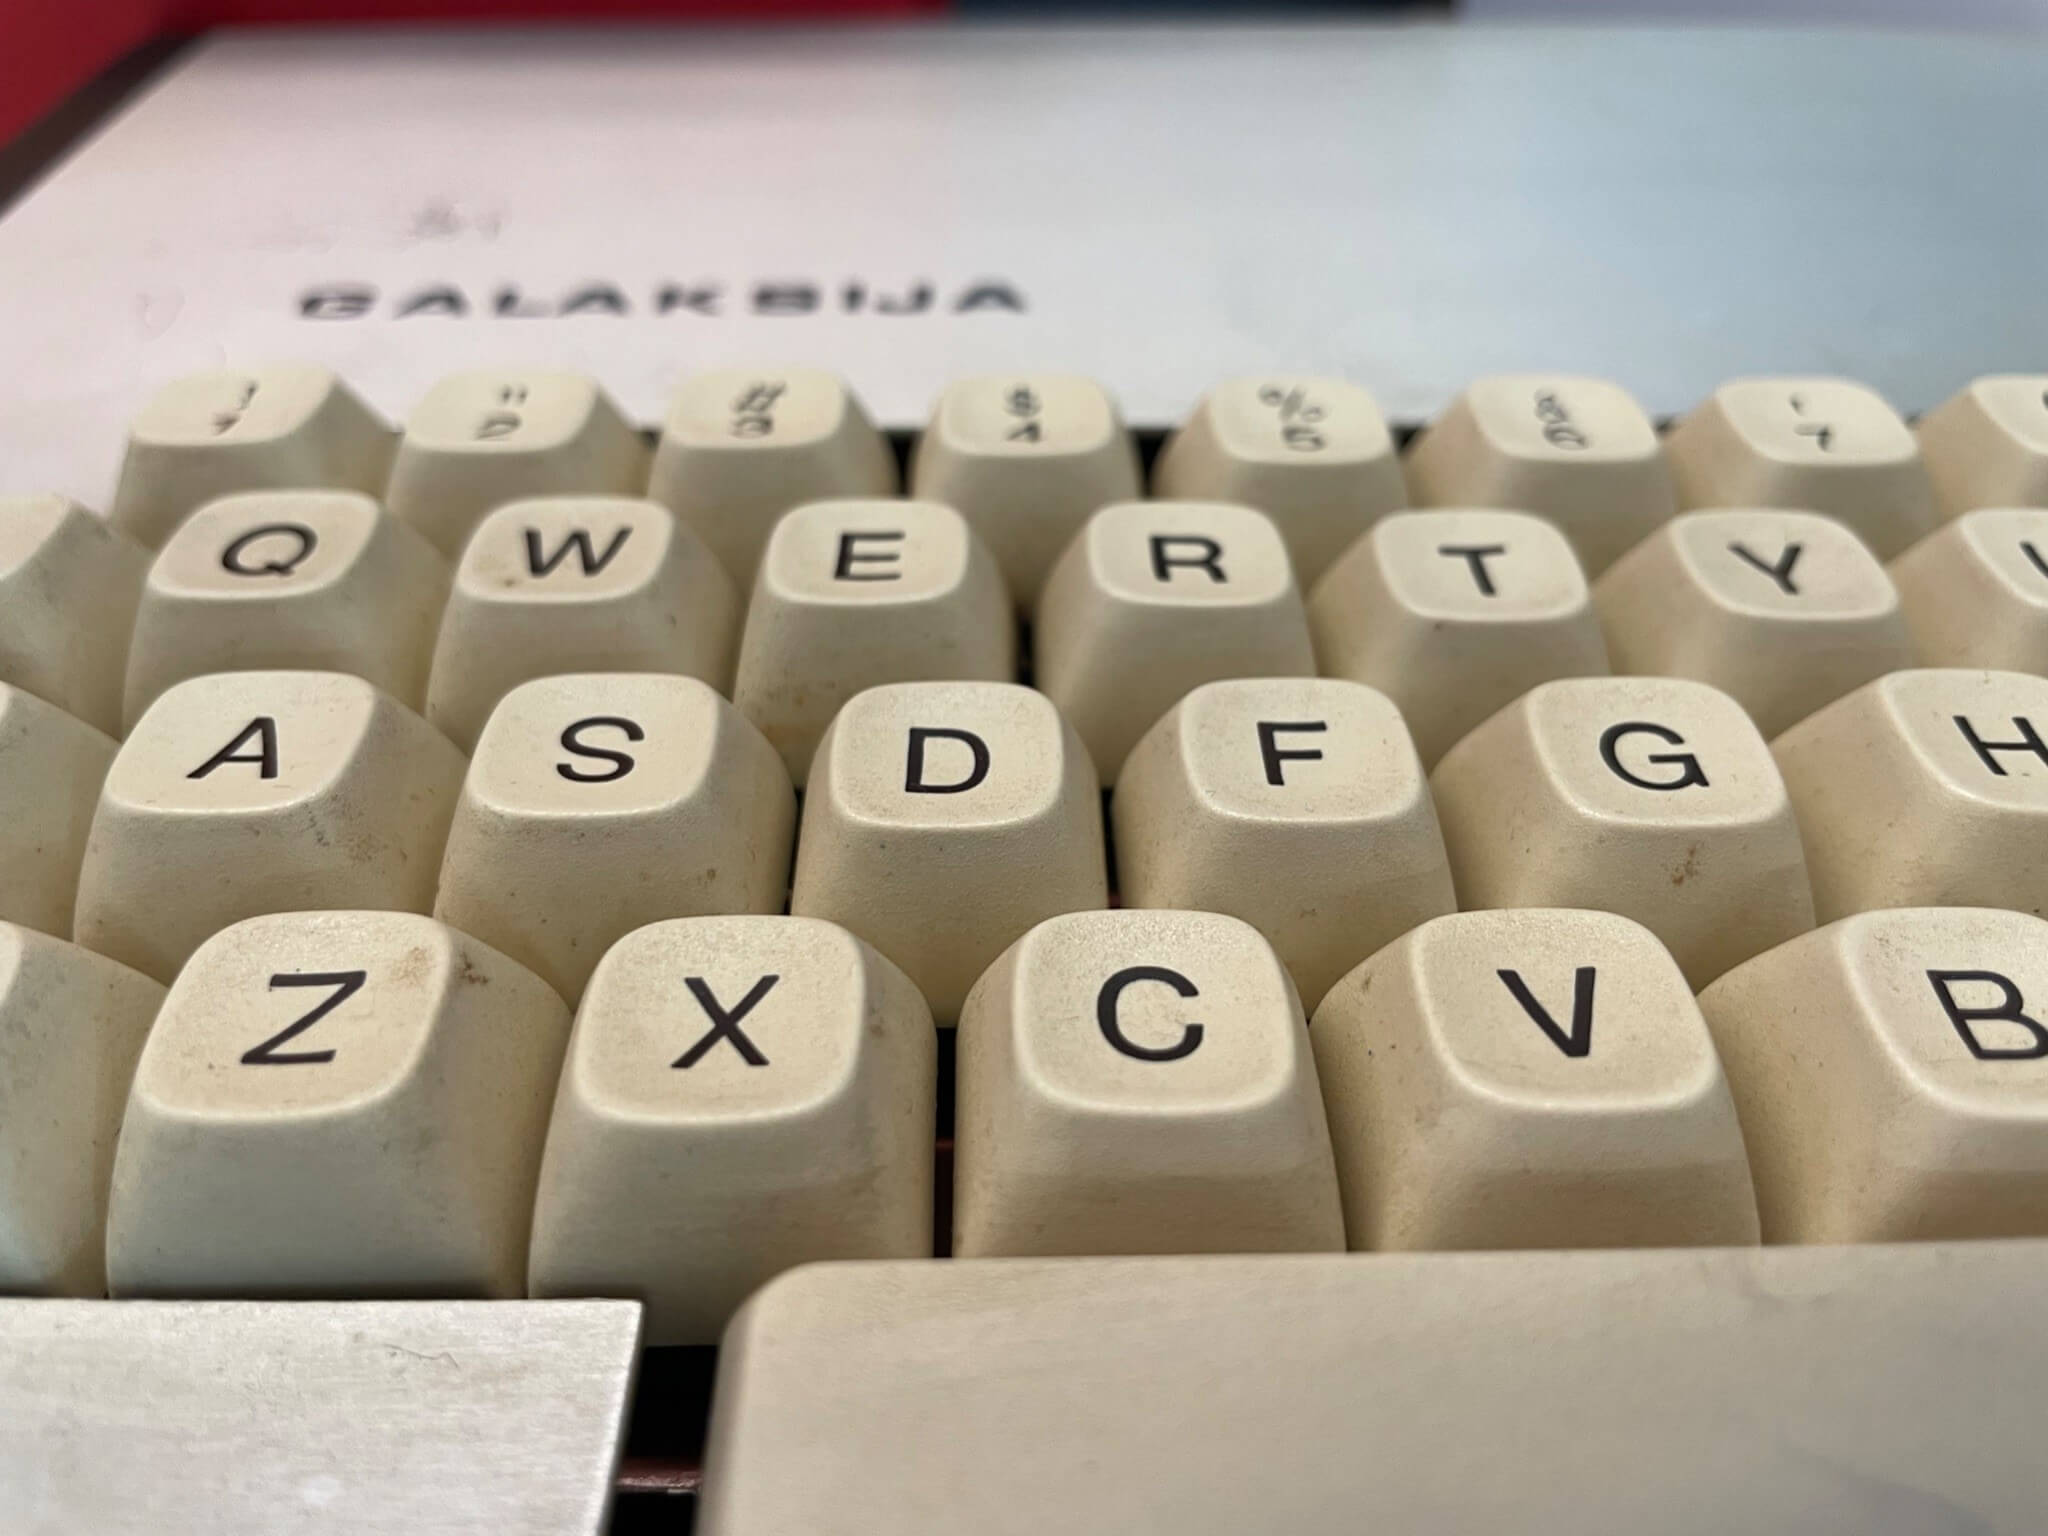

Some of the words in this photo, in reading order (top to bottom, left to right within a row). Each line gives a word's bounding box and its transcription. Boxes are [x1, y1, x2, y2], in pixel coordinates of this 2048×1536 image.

[220, 524, 317, 577] Q
[524, 528, 631, 578] W
[833, 533, 904, 581] E
[1150, 535, 1227, 583] R
[1440, 545, 1505, 597] T
[1729, 544, 1803, 595] Y
[186, 716, 278, 780] A
[557, 716, 645, 784] S
[905, 726, 990, 795] D
[1257, 721, 1328, 786] F
[1600, 722, 1709, 790] G
[1953, 716, 2048, 777] H
[241, 971, 366, 1066] Z
[671, 974, 780, 1069] X
[1097, 966, 1204, 1063] C
[1497, 967, 1597, 1058] V
[1926, 970, 2048, 1061] B
